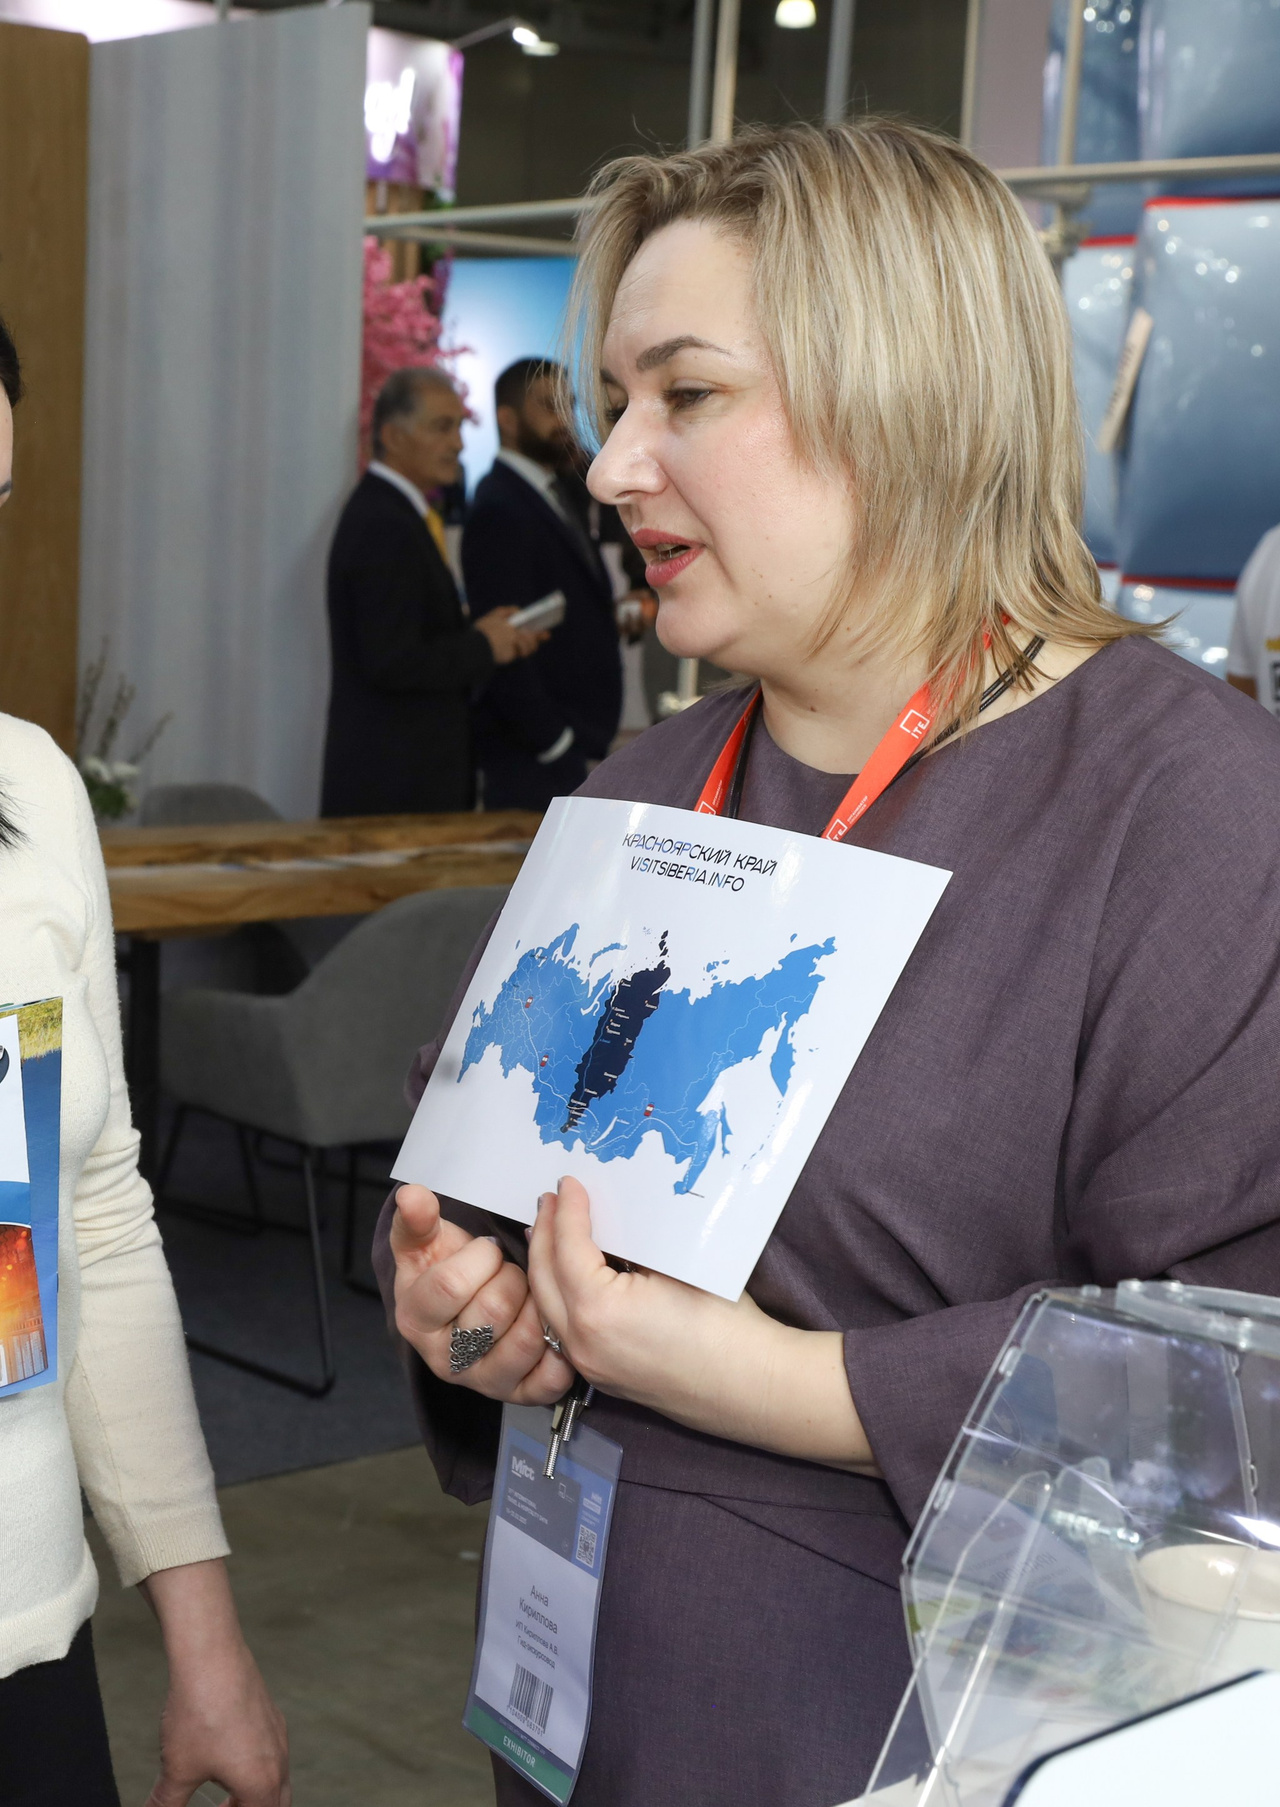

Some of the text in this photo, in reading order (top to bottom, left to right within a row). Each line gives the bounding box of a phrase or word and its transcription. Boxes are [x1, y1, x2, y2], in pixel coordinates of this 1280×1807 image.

[622, 833, 778, 876] КРАСНОЯРСКИЙ КРАЙ
[630, 856, 744, 891] VISITSIBERIA.INFO
[530, 1585, 549, 1607] Анна
[519, 1597, 557, 1634] Кириллова
[503, 1735, 536, 1768] EXHIBITOR
